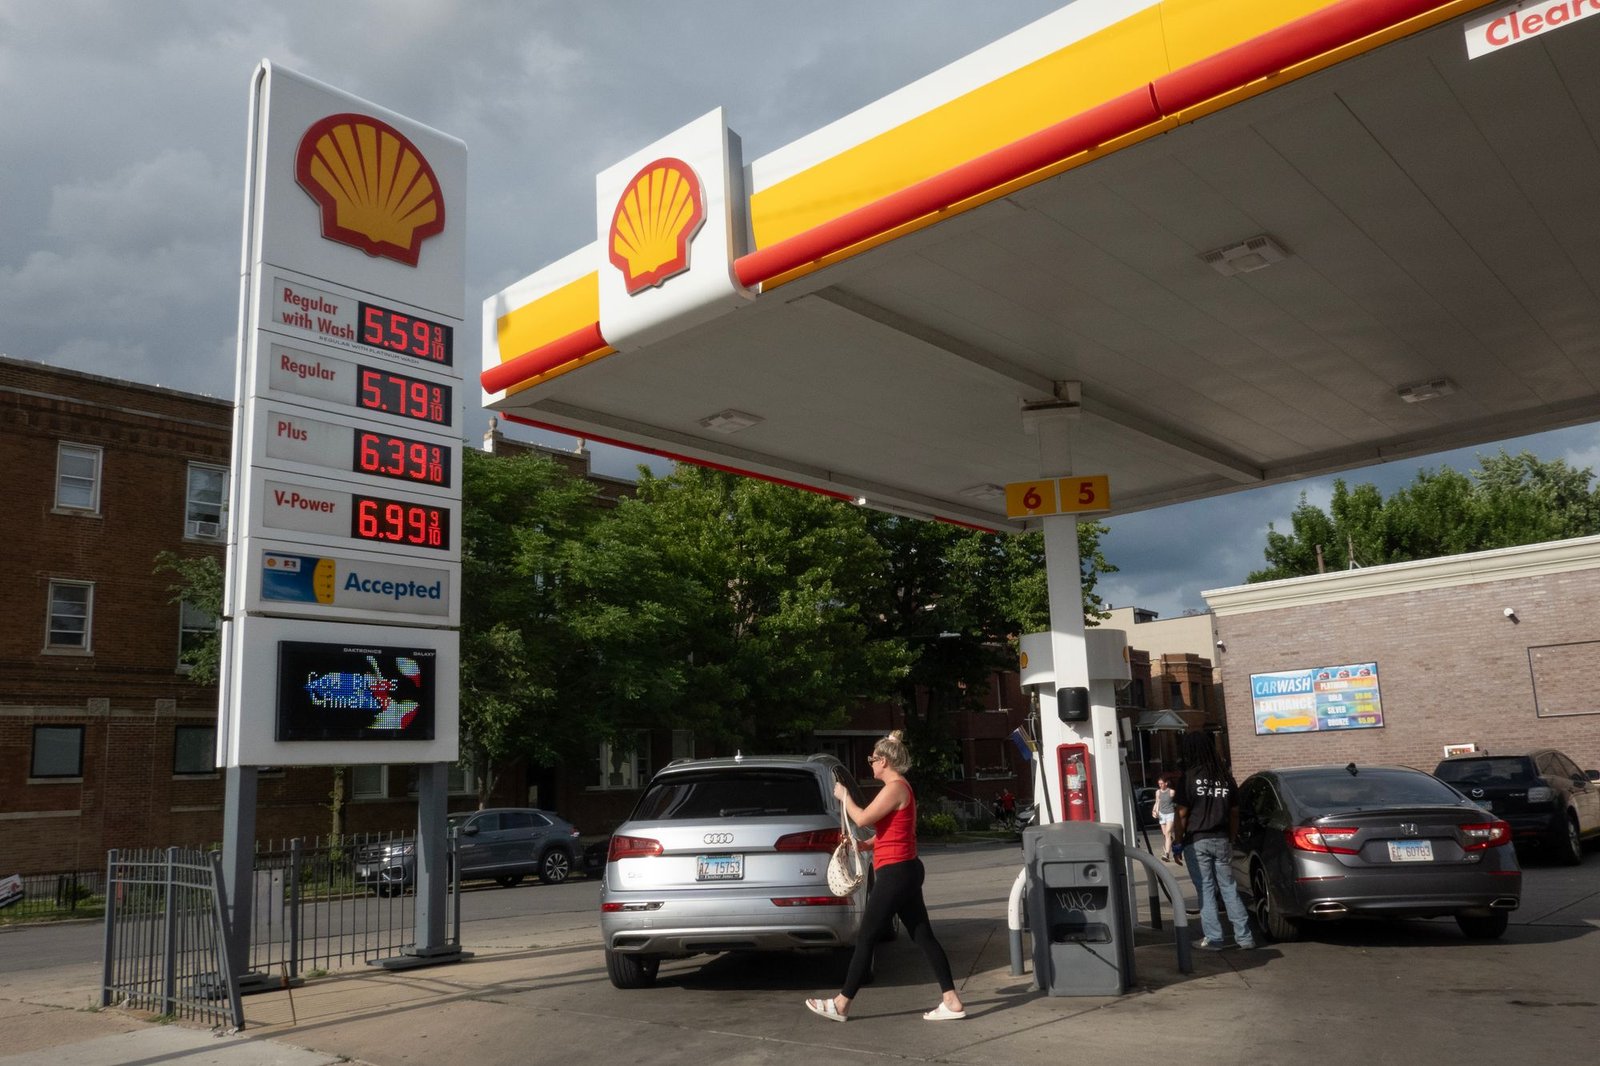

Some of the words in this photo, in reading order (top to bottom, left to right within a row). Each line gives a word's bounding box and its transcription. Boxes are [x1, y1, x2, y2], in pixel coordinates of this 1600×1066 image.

[283, 287, 338, 315] Regular
[282, 311, 313, 330] with
[317, 317, 355, 340] Wash
[364, 307, 430, 356] 5.59
[319, 335, 350, 347] REGULAR
[352, 343, 369, 352] WITH
[369, 348, 400, 360] PLATINUM
[401, 355, 420, 364] WASH
[281, 354, 336, 382] Regular
[362, 370, 428, 418] 5.79
[278, 421, 308, 441] Plus
[361, 434, 428, 480] 6.39
[274, 490, 336, 513] V-Power
[1023, 487, 1042, 509] 6
[1078, 482, 1095, 504] 5
[359, 500, 426, 543] 6.99
[344, 572, 441, 600] Accepted
[714, 861, 741, 874] 75753
